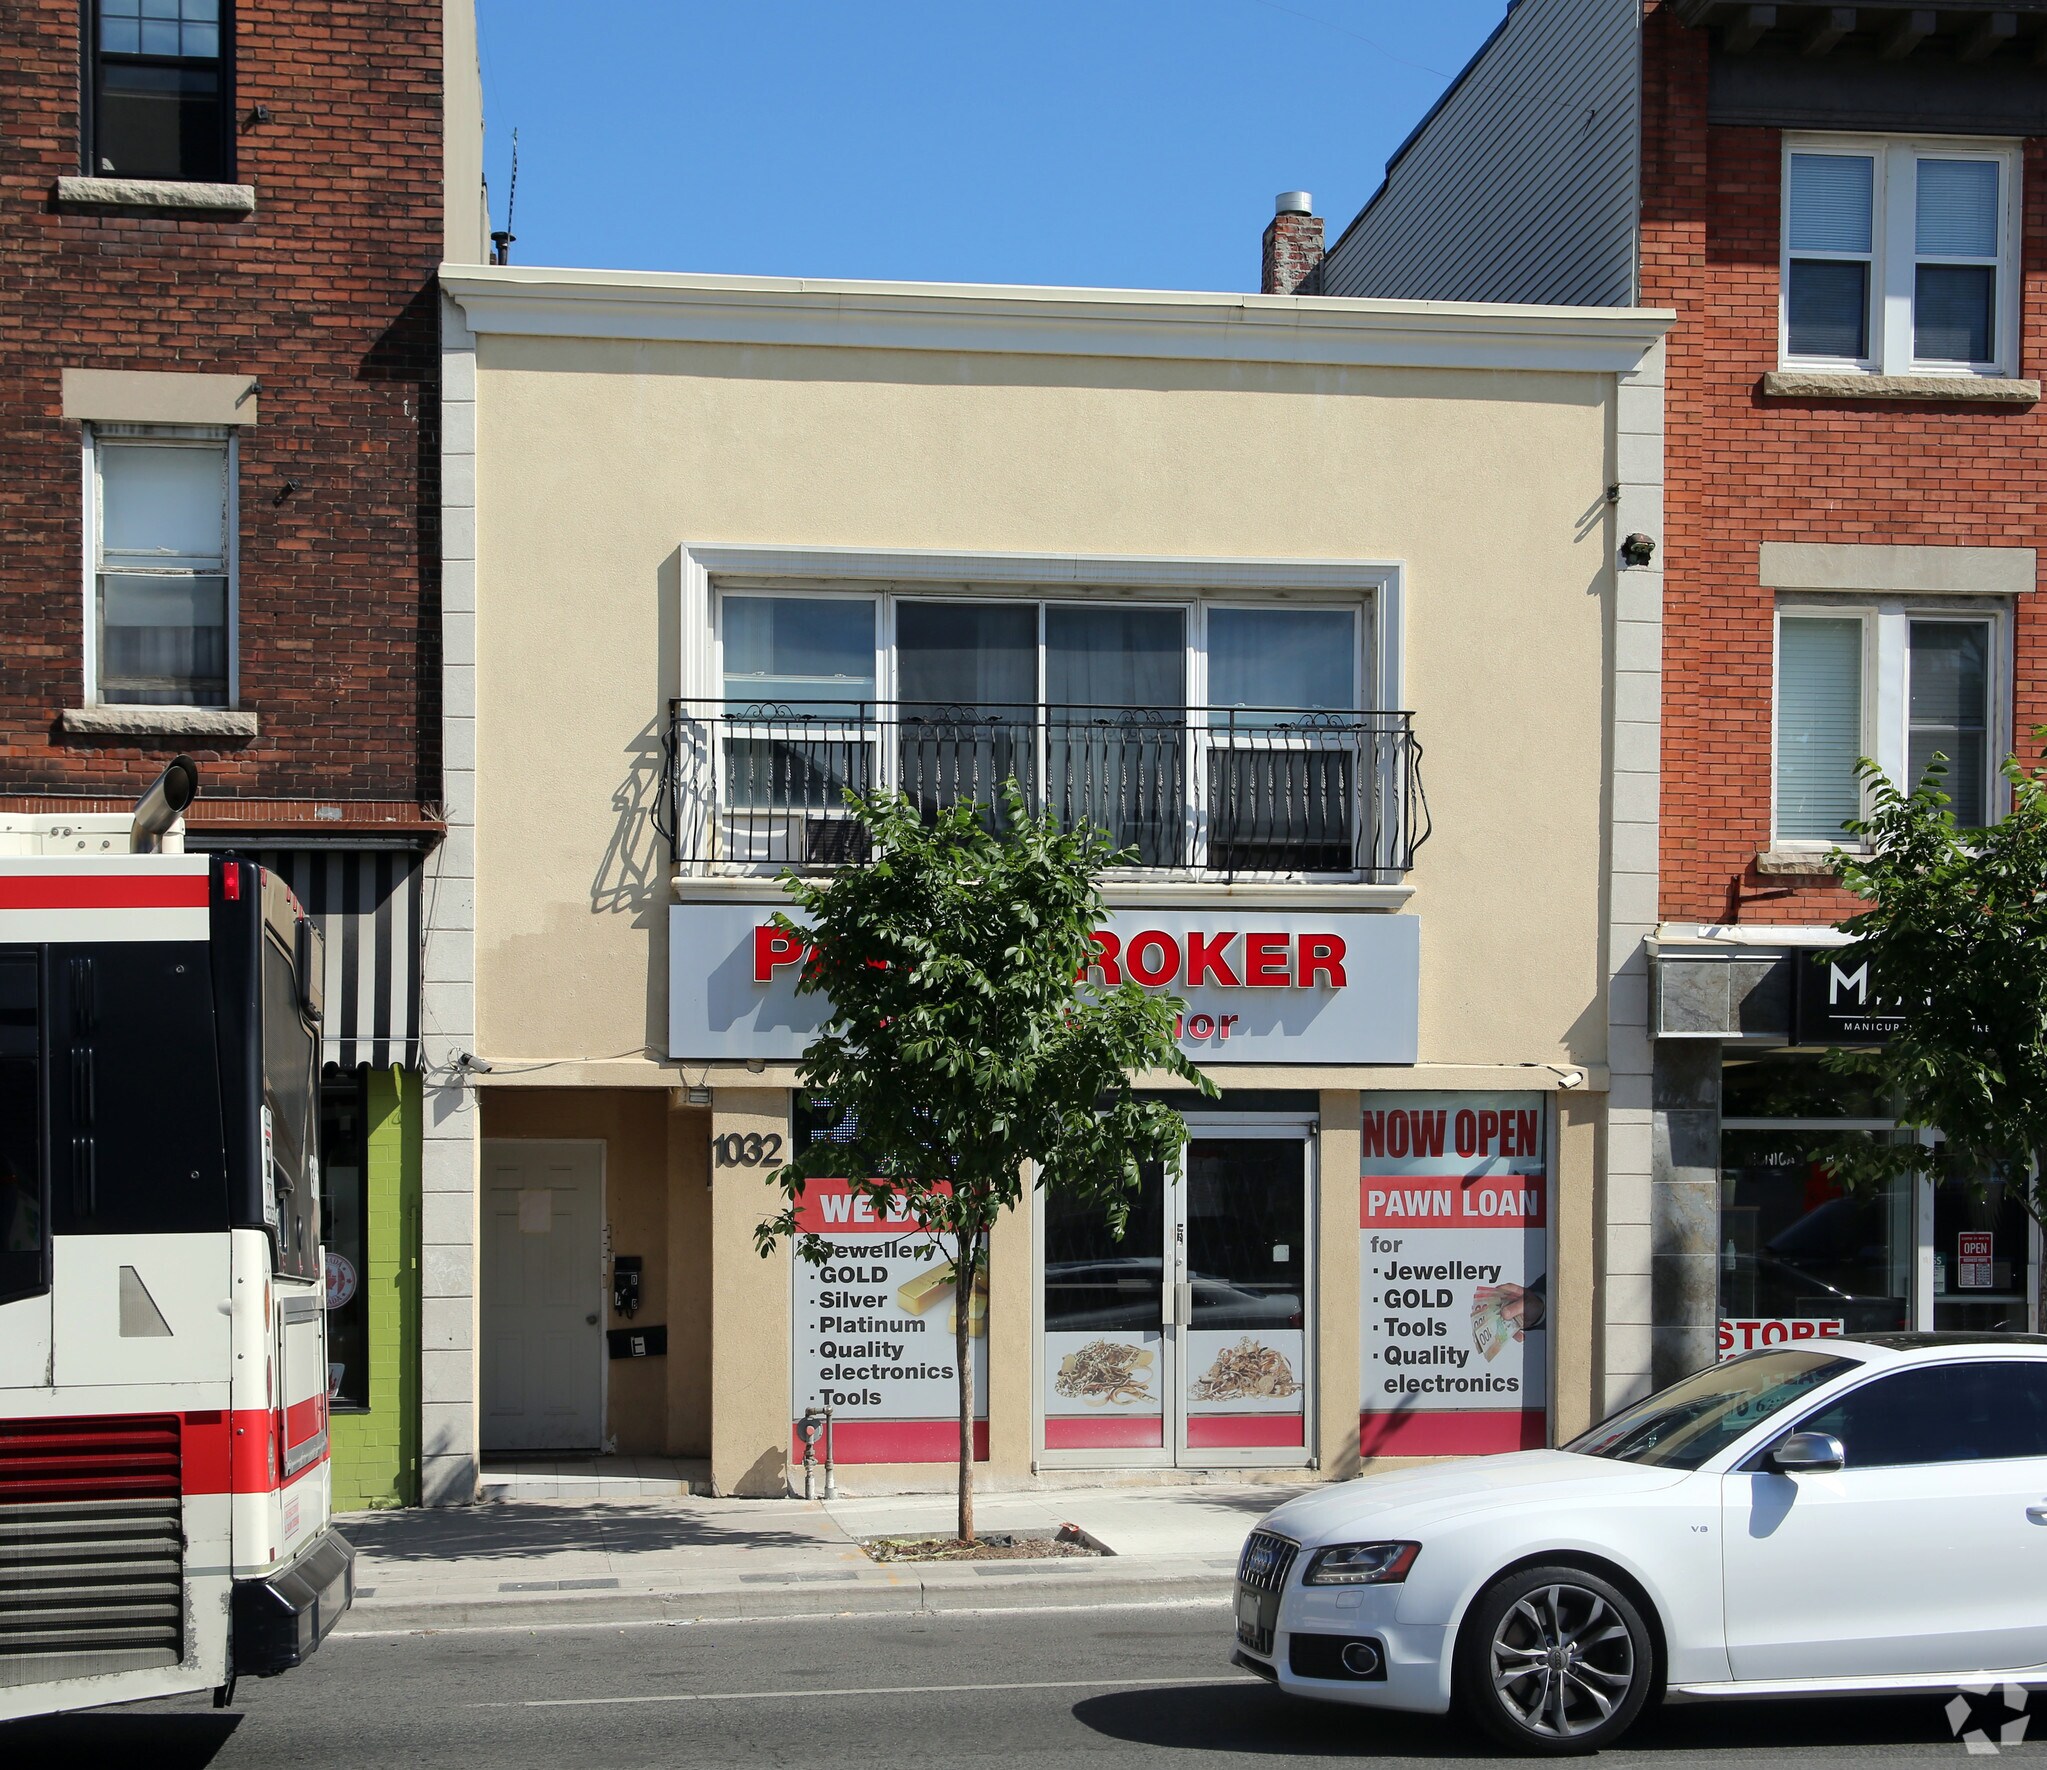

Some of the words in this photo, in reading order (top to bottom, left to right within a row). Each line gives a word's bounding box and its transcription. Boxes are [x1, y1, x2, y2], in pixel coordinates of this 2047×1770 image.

[753, 925, 1347, 988] PROKER
[1844, 1022, 1909, 1032] MANICUR
[1362, 1109, 1447, 1158] NOW
[1455, 1109, 1538, 1158] OPEN
[713, 1132, 783, 1168] 1032
[819, 1194, 875, 1223] WE
[1368, 1190, 1451, 1217] PAWN
[1462, 1189, 1538, 1217] LOAN
[1370, 1235, 1403, 1253] for
[1964, 1242, 1987, 1254] OPEN
[820, 1266, 888, 1284] GOLD
[1383, 1260, 1502, 1284] Jewellery
[819, 1291, 888, 1309] Silver
[1383, 1288, 1454, 1309] GOLD
[819, 1316, 926, 1334] Platinum
[1383, 1317, 1448, 1337] Tools
[819, 1340, 905, 1360] Quality
[1383, 1345, 1470, 1369] Quality
[819, 1362, 954, 1381] electronics
[1383, 1373, 1520, 1394] electronics
[819, 1388, 882, 1406] Tools
